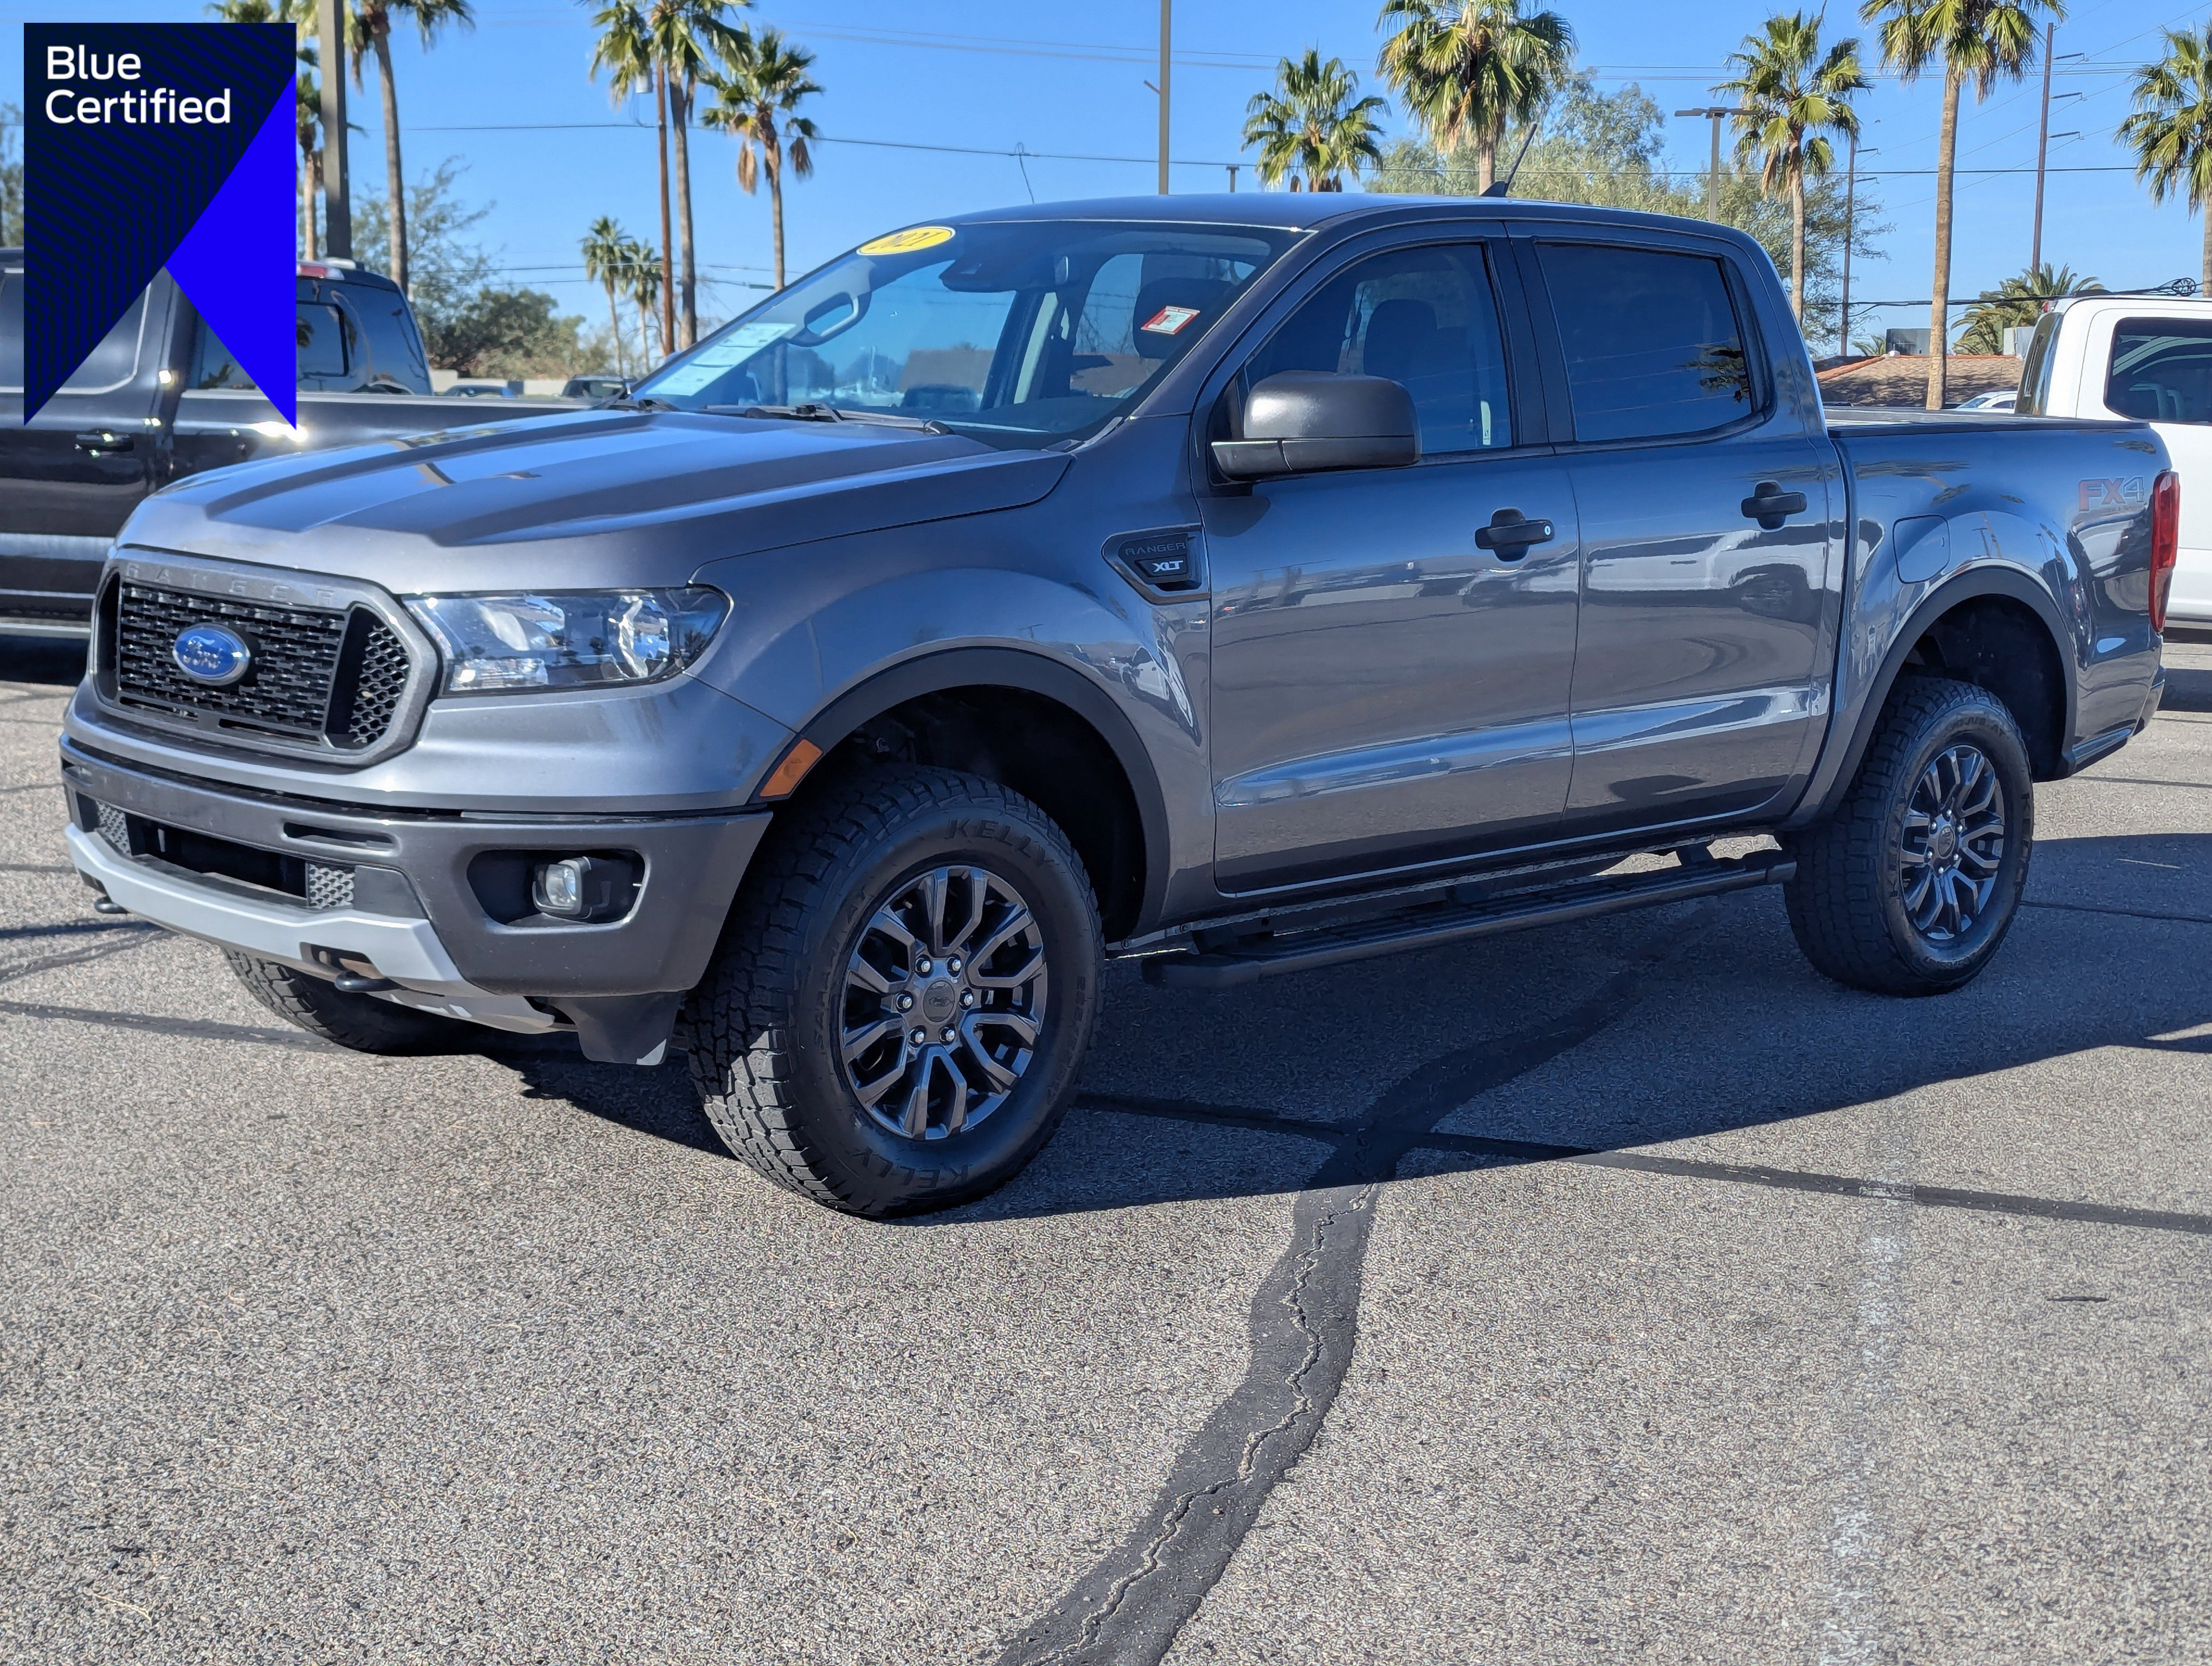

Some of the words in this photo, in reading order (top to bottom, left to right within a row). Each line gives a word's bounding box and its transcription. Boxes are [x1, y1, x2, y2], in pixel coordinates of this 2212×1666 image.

[2078, 476, 2144, 512] FX4
[1124, 542, 1186, 556] RANGER
[1152, 560, 1184, 573] XLT
[943, 817, 1055, 867] KELLY
[852, 1145, 971, 1189] KELLY
